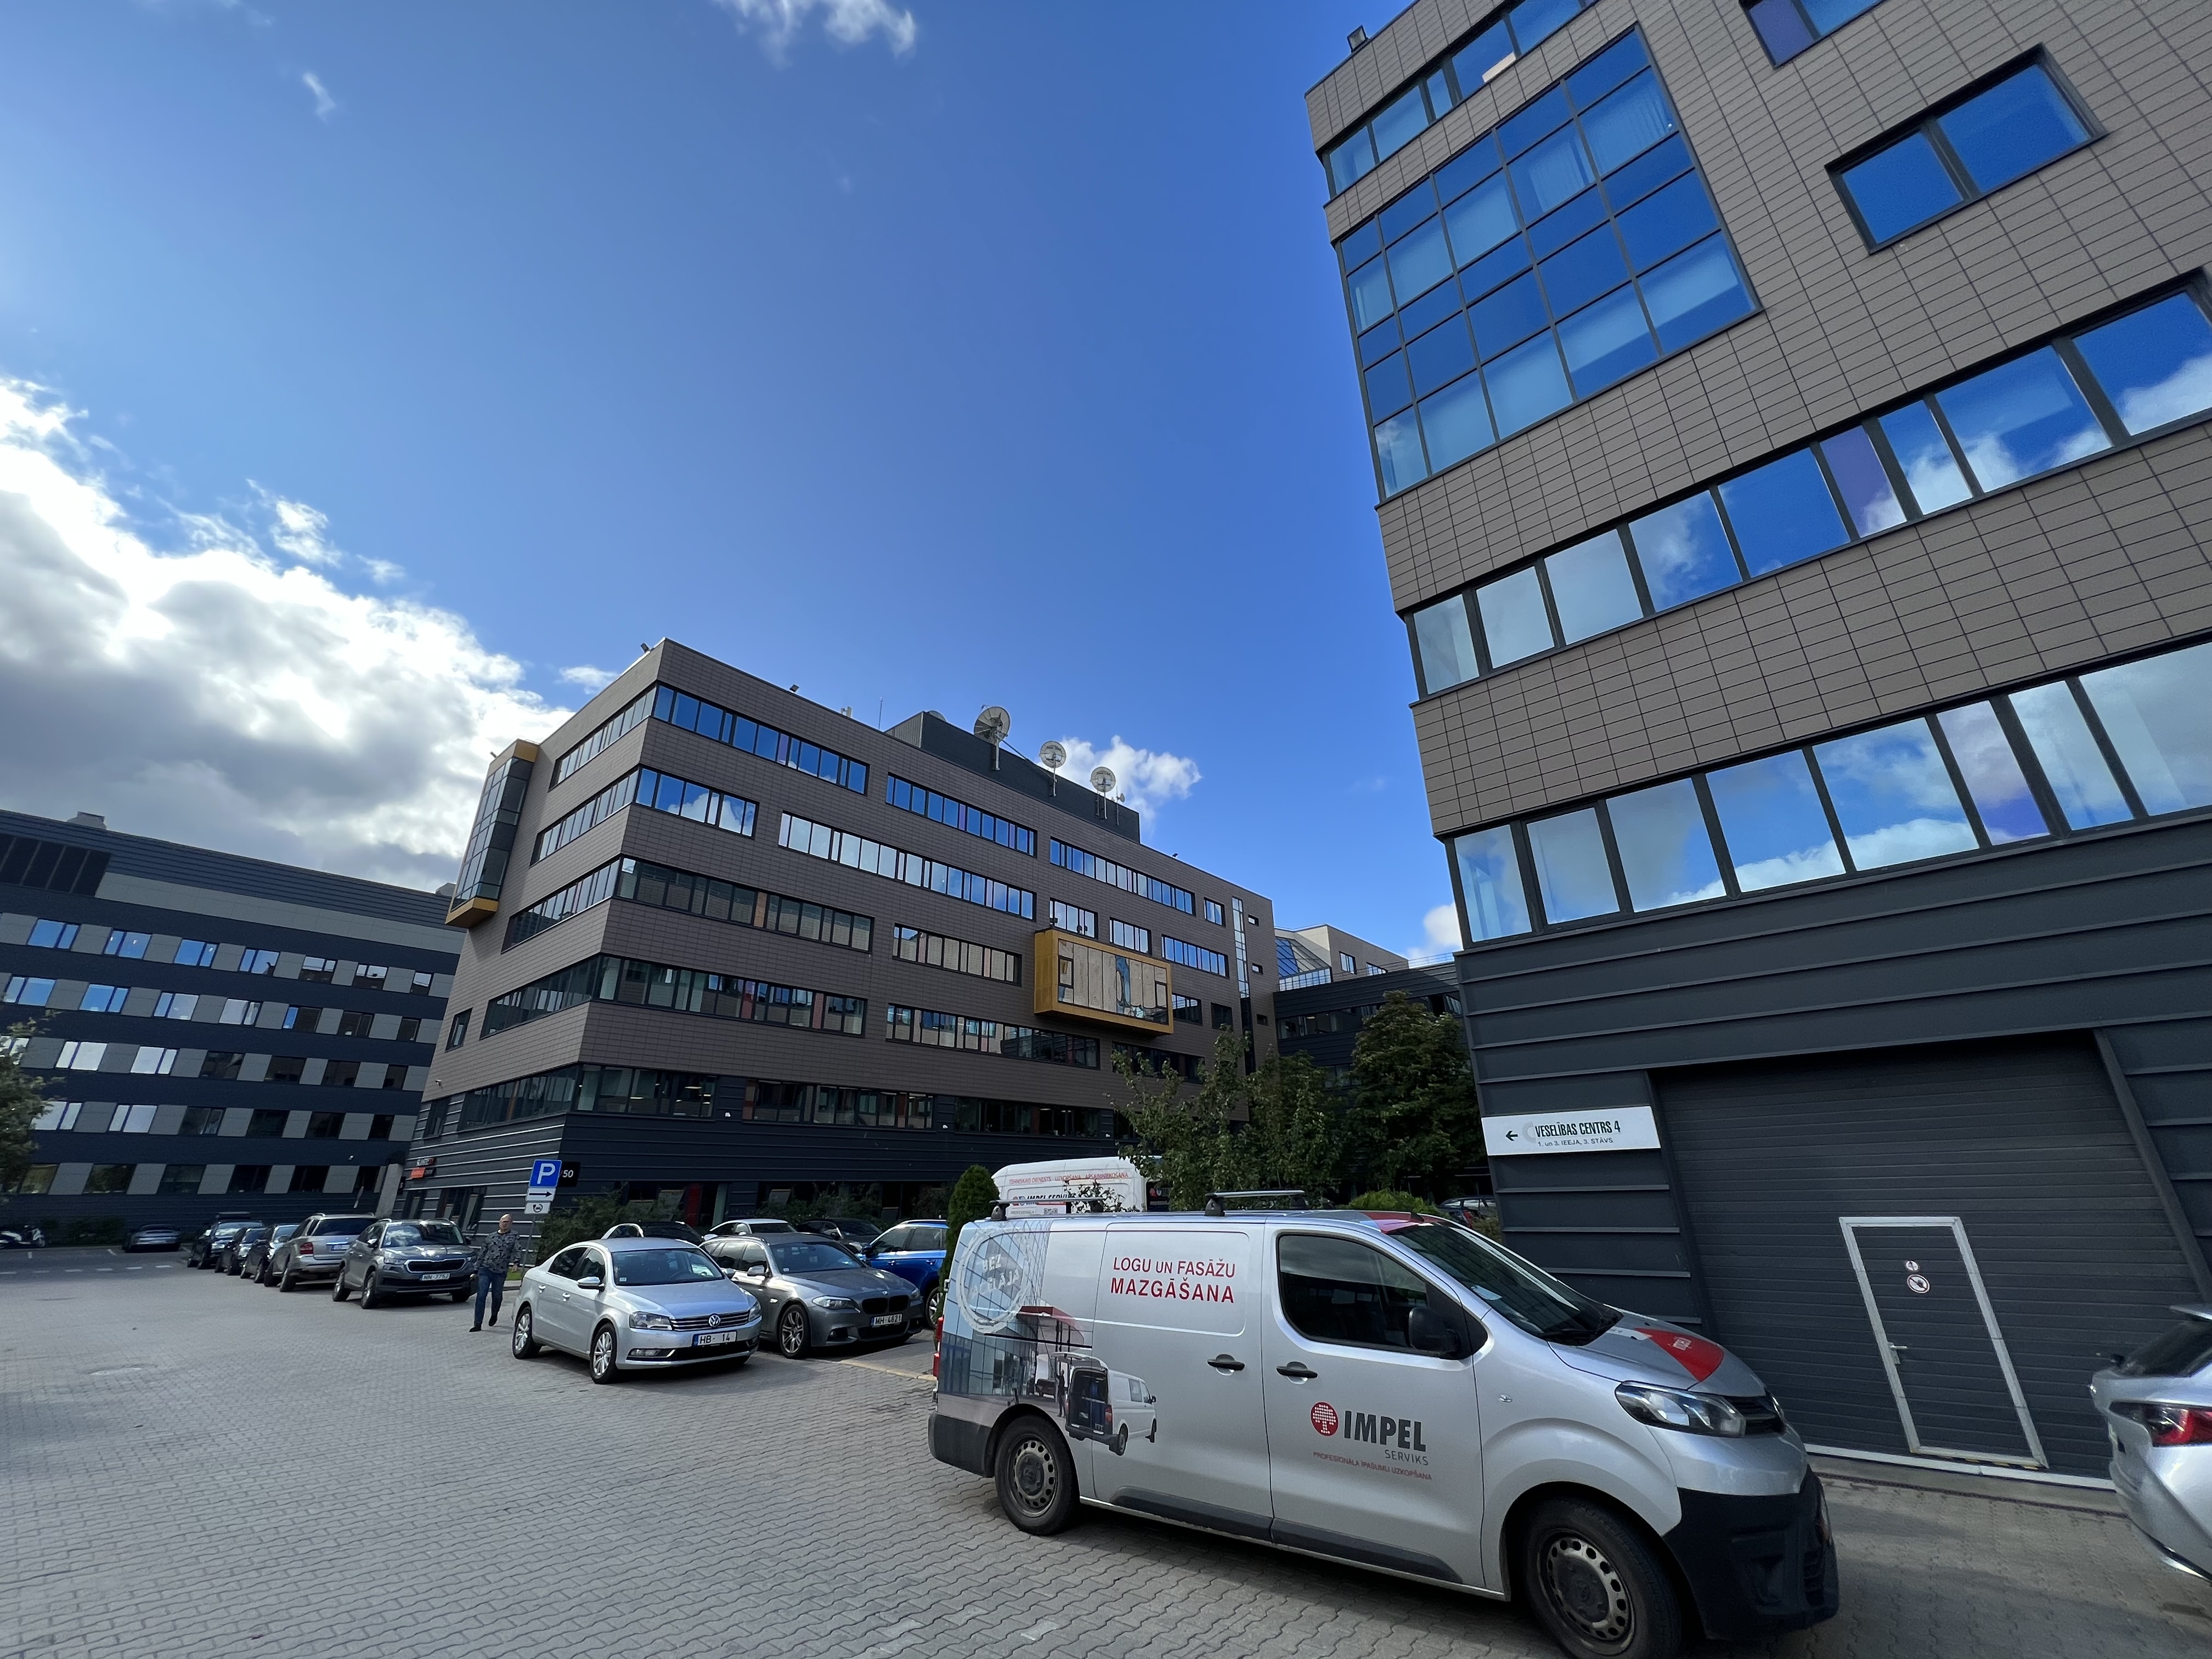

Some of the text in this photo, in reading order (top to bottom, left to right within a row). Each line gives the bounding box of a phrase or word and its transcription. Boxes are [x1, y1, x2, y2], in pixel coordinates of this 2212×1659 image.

[1535, 1120, 1621, 1137] VESELĪBAS CENTRS 4
[537, 1163, 556, 1184] P
[982, 1254, 1002, 1273] BEZ
[1113, 1257, 1235, 1278] LOGU UN FASĀŽU
[1110, 1277, 1234, 1304] MAZGĀŠANA
[1344, 1410, 1426, 1452] IMPEL
[1385, 1449, 1429, 1466] SERVIKS
